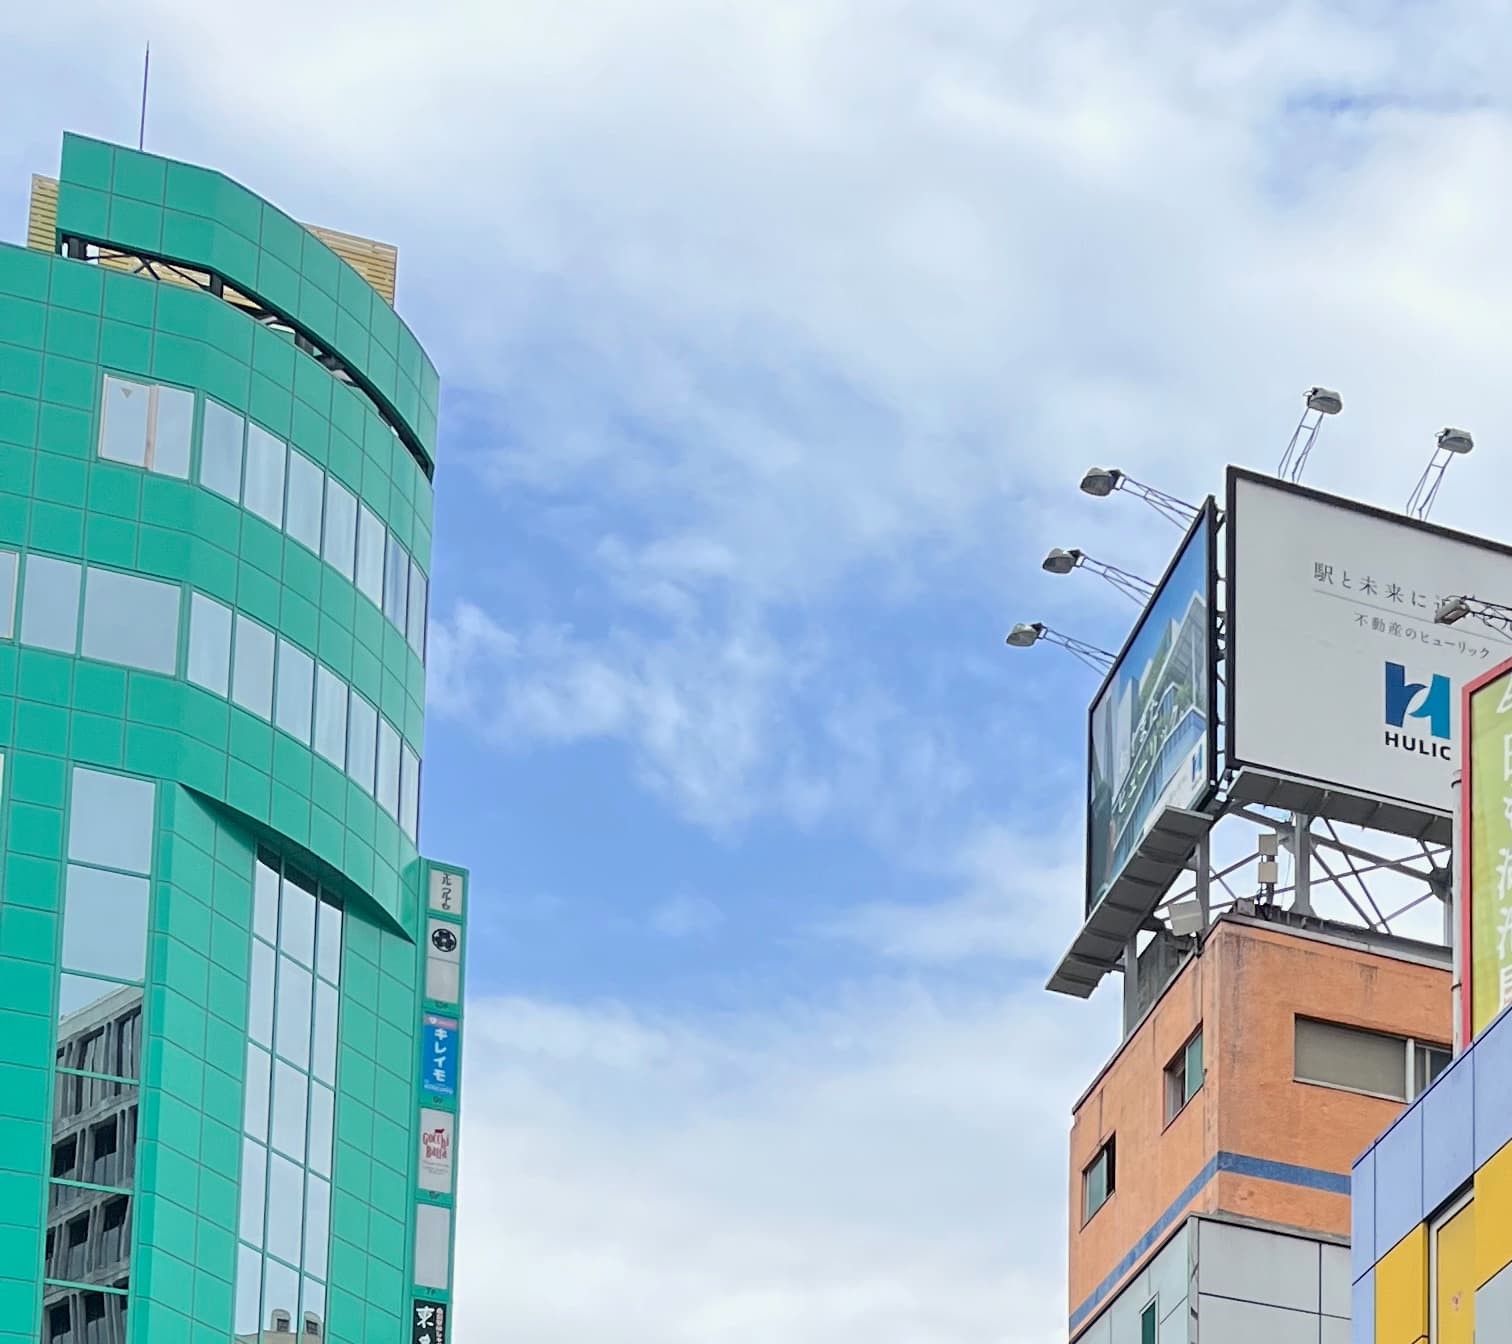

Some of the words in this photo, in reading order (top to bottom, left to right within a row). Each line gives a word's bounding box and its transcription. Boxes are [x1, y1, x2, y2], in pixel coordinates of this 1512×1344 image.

[1355, 612, 1490, 660] 不動産のヒューリック
[1385, 731, 1452, 762] HULIC
[433, 1028, 449, 1083] キレイモ
